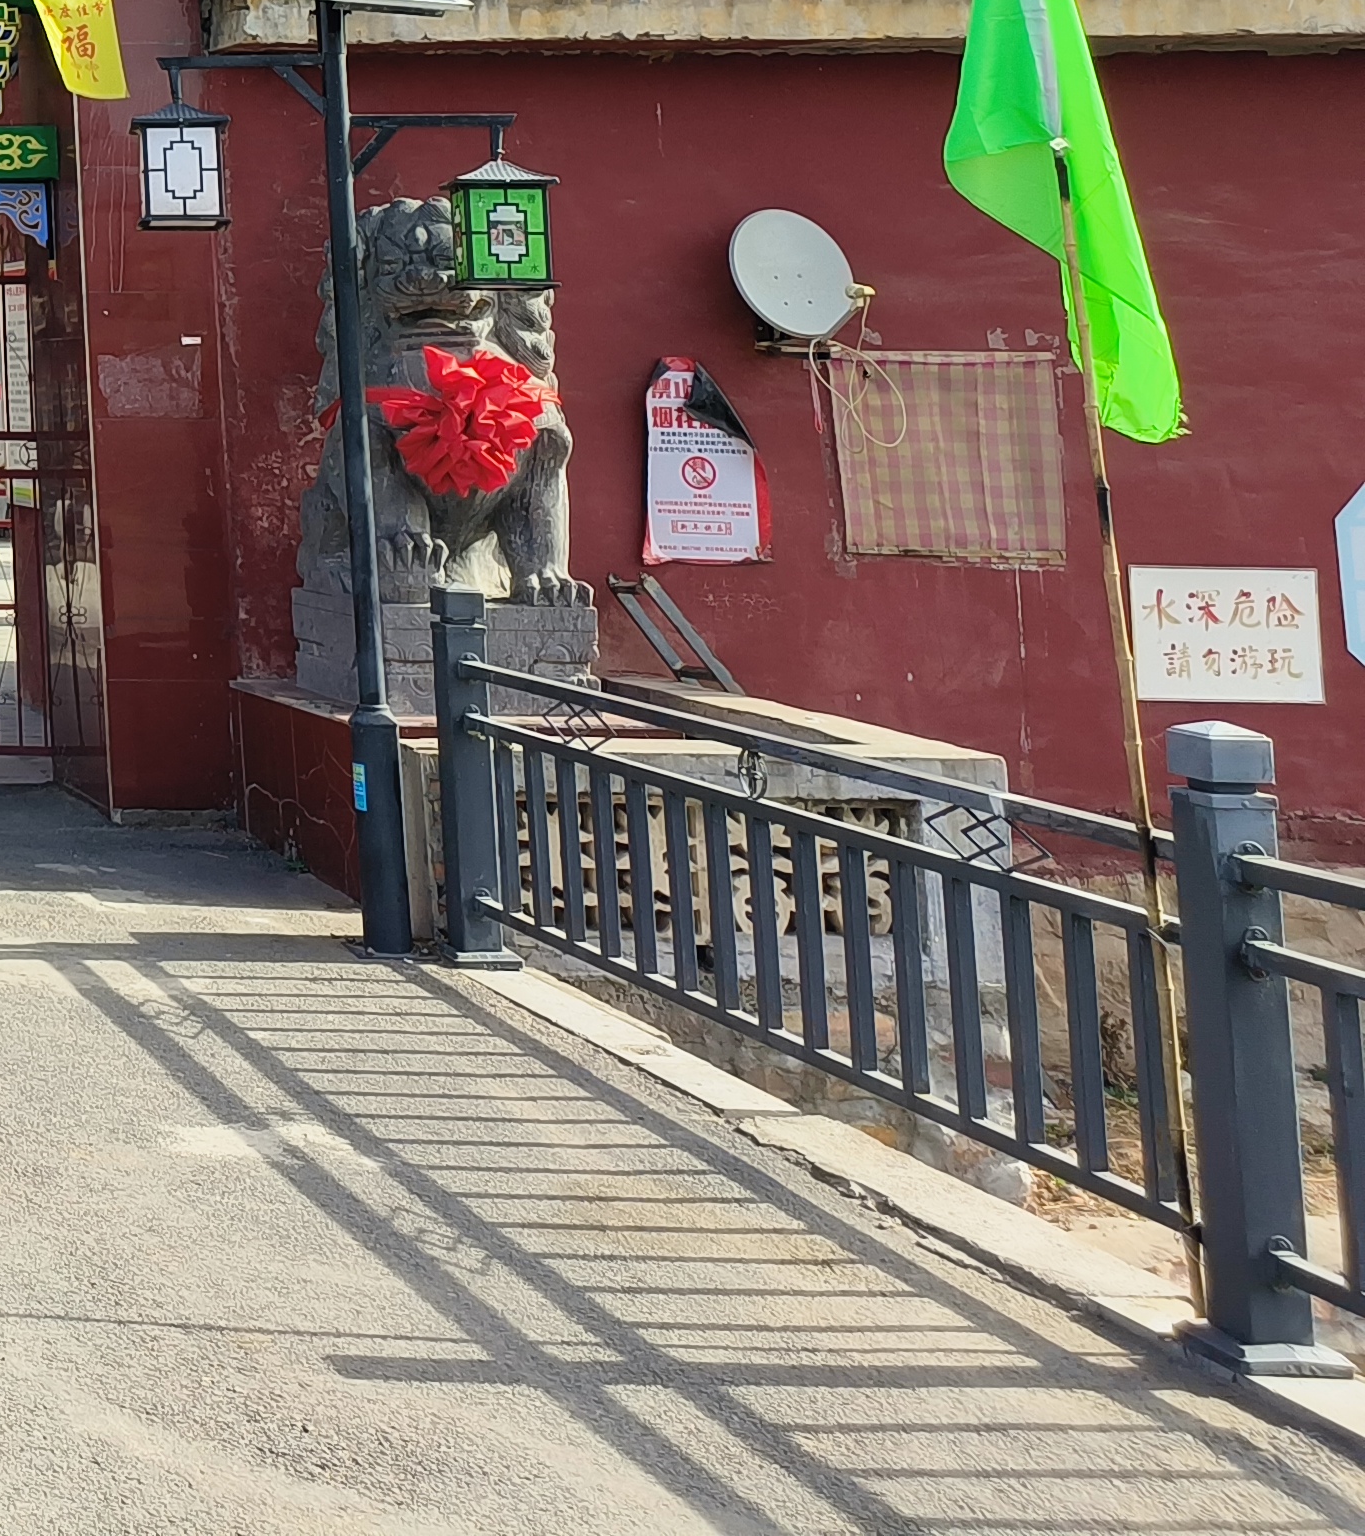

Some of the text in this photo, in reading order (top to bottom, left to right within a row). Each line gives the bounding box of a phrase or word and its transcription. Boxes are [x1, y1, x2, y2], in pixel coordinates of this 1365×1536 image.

[60, 23, 96, 60] 福
[652, 405, 718, 430] 烟花
[1141, 588, 1306, 632] 水深危险
